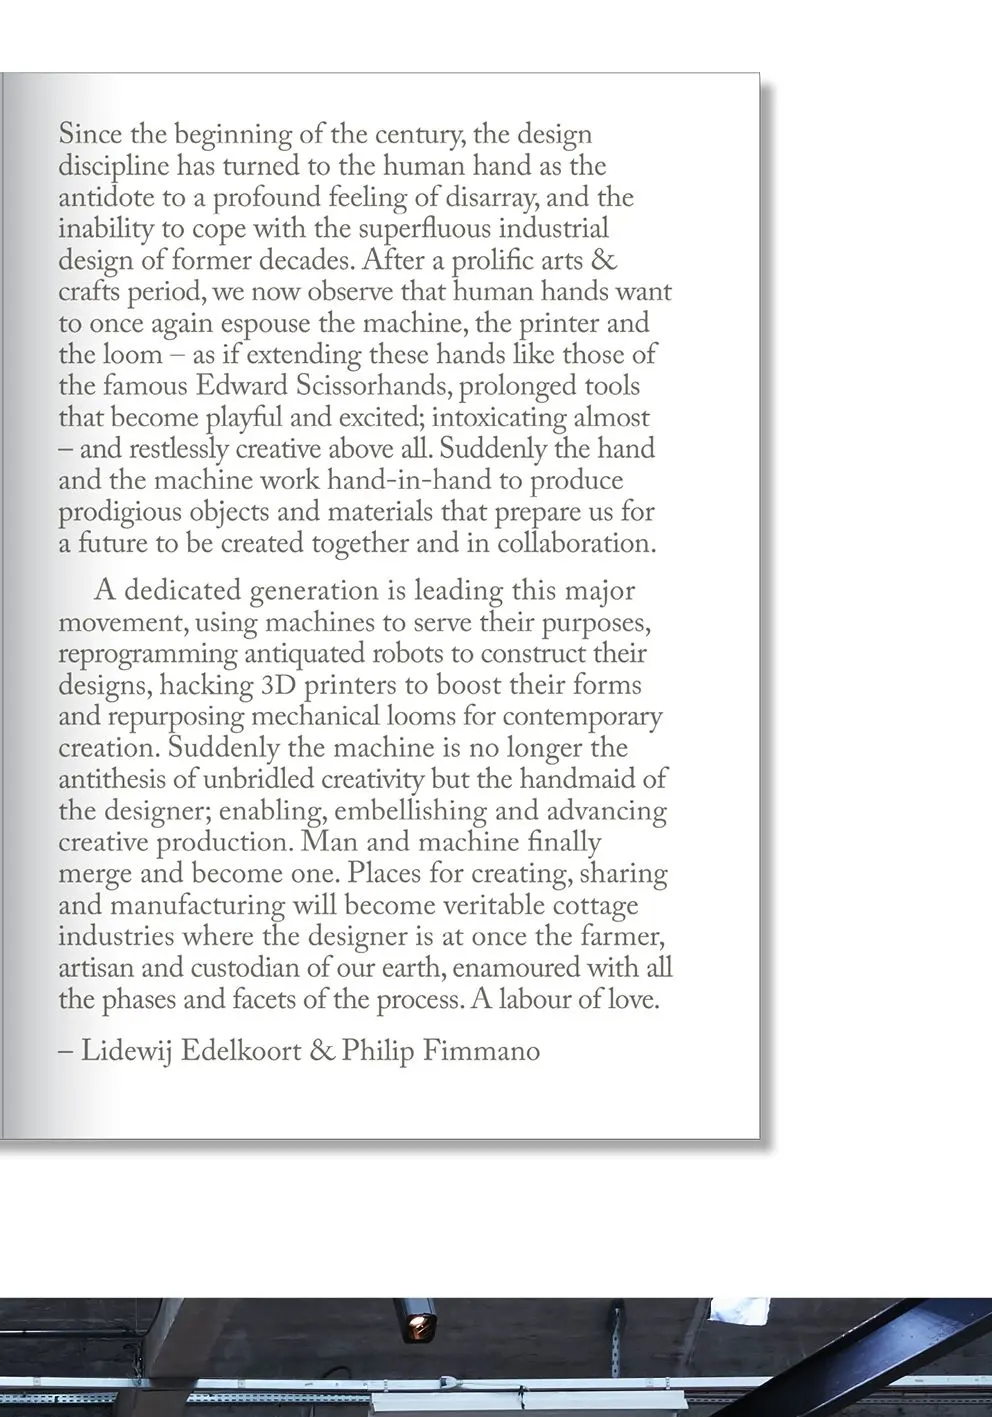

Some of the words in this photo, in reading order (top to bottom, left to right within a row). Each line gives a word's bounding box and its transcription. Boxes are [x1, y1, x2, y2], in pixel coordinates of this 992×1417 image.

[59, 120, 122, 144] Since
[131, 121, 167, 144] the
[174, 121, 293, 152] beginning
[300, 121, 327, 144] of
[330, 121, 368, 144] the
[375, 127, 467, 151] century,
[473, 121, 510, 144] the
[518, 121, 591, 152] design
[94, 577, 115, 600] A
[125, 577, 241, 601] dedicated
[249, 579, 378, 608] generation
[388, 579, 406, 600] is
[415, 577, 504, 608] leading
[512, 577, 556, 600] this
[566, 579, 636, 608] major
[58, 986, 95, 1009] the
[102, 986, 176, 1017] phases
[184, 986, 225, 1009] and
[233, 986, 296, 1009] facets
[303, 986, 331, 1009] of
[333, 986, 369, 1009] the
[377, 994, 465, 1017] process.
[470, 986, 493, 1009] A
[499, 986, 572, 1009] labour
[578, 986, 606, 1009] of
[608, 986, 659, 1009] love.
[81, 1038, 172, 1068] Lidewij
[182, 1038, 302, 1061] Edelkoort
[310, 1038, 336, 1061] &
[342, 1038, 414, 1068] Philip
[423, 1038, 540, 1061] Fimmano
